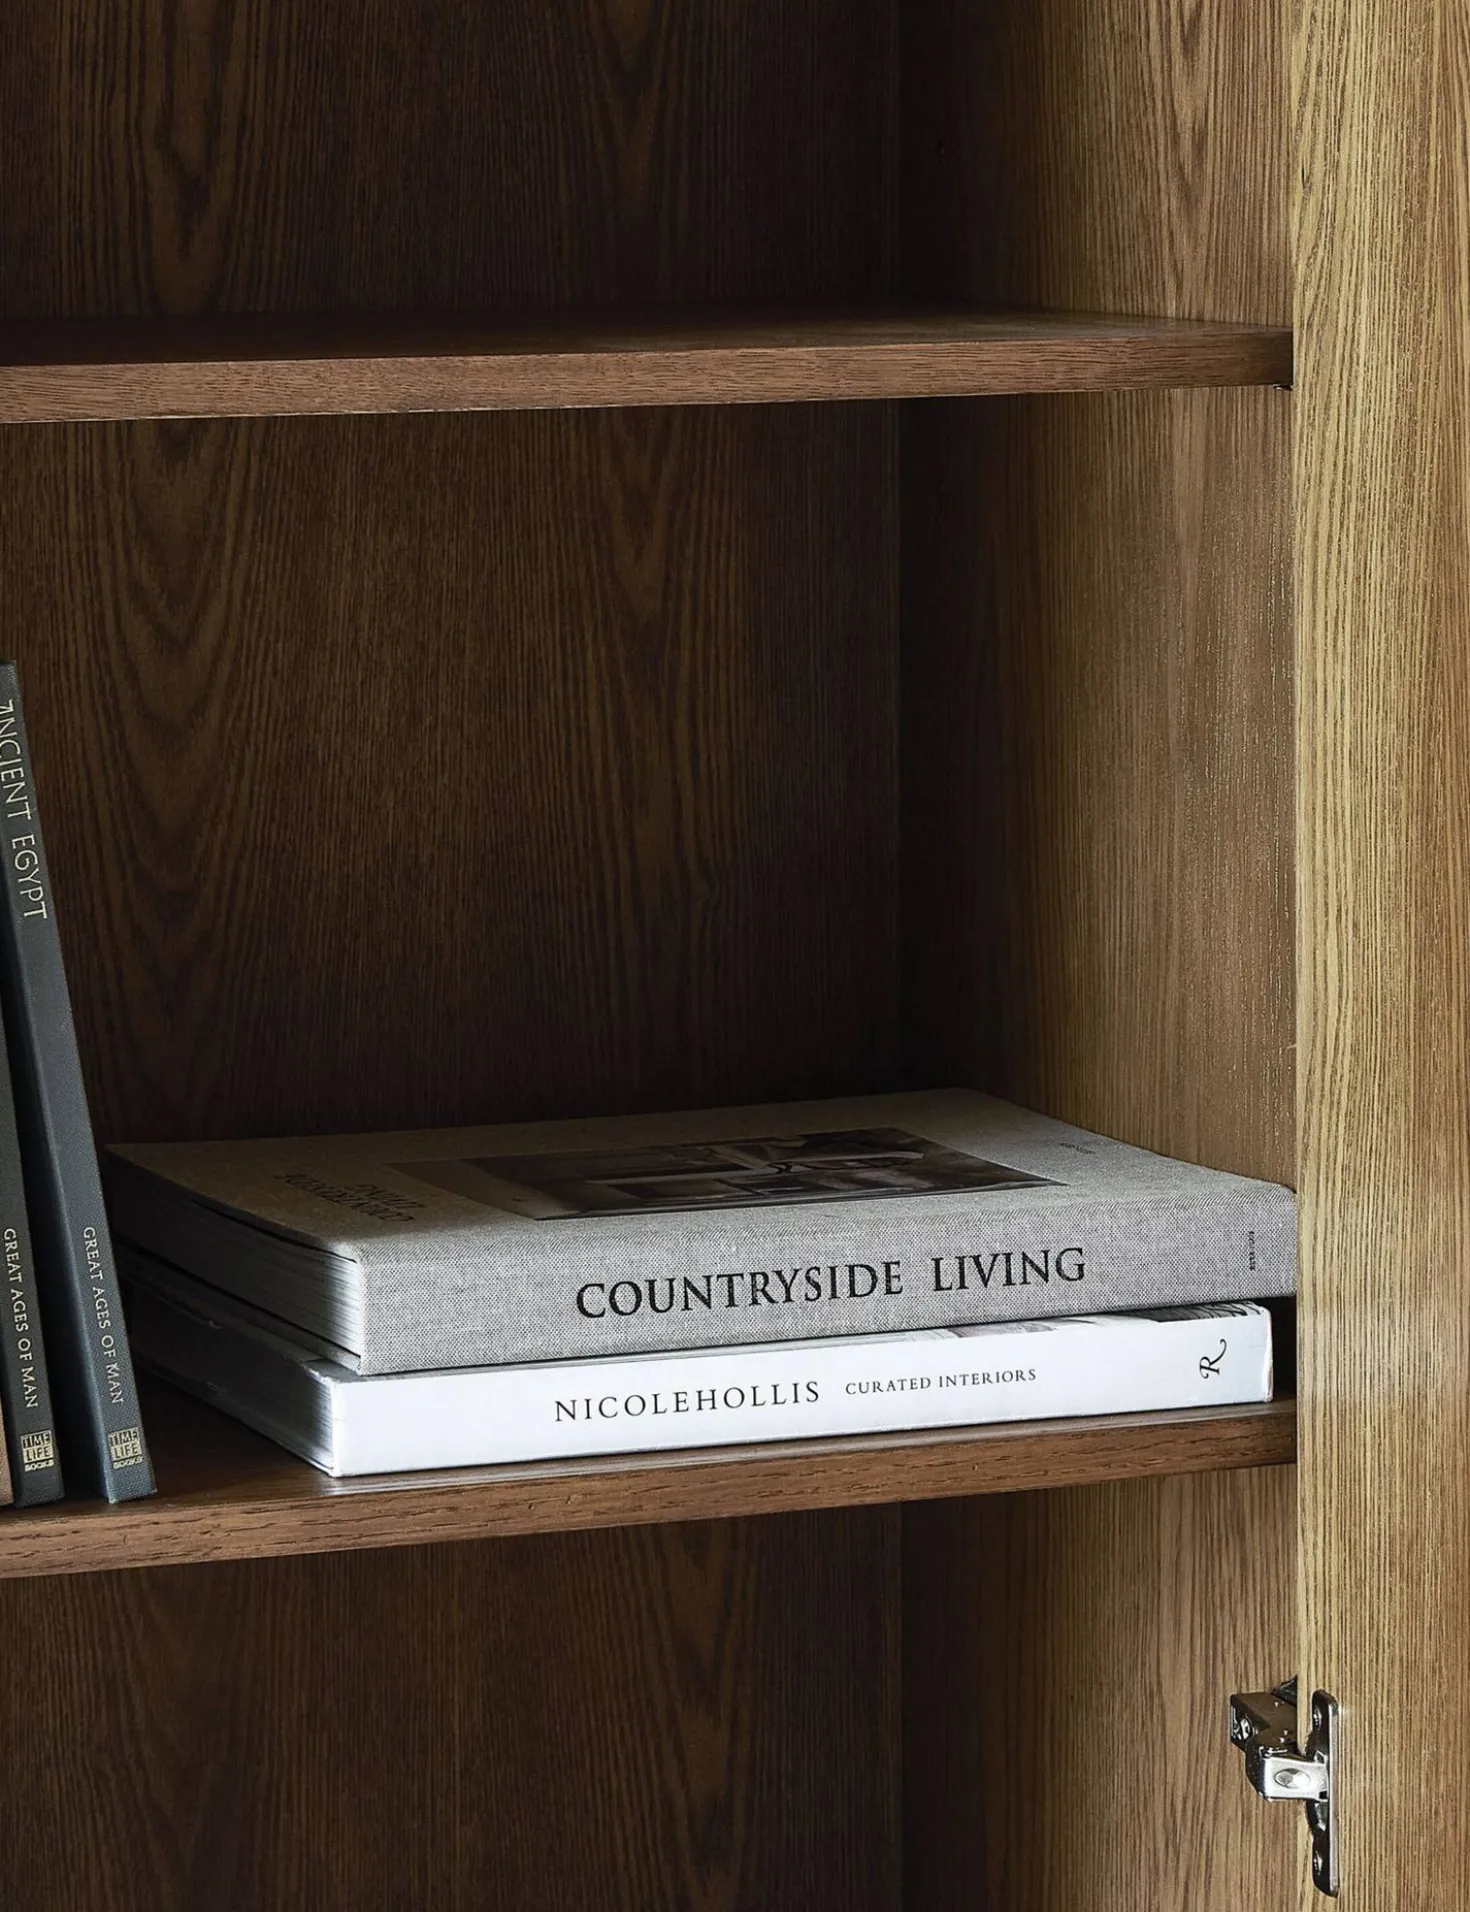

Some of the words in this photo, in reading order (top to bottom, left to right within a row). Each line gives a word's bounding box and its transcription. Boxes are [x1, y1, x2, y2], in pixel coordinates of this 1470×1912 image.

[11, 834, 48, 919] EGYPT
[4, 1228, 22, 1283] GREAT
[83, 1226, 104, 1280] GREAT
[576, 1260, 904, 1319] COUNTRYSIDE
[932, 1246, 1087, 1293] LIVING
[11, 1289, 29, 1332] AGES
[92, 1286, 112, 1329] AGES
[18, 1338, 33, 1361] OF
[101, 1335, 116, 1358] OF
[22, 1366, 39, 1408] MAN
[106, 1362, 124, 1404] MAN
[555, 1381, 819, 1422] NICOLEHOLLIS
[845, 1377, 932, 1395] CURATED
[939, 1368, 1036, 1388] INTERIORS
[22, 1433, 50, 1447] TIME
[26, 1446, 51, 1461] LIFE
[109, 1430, 138, 1446] TIME
[113, 1442, 138, 1459] LIFE
